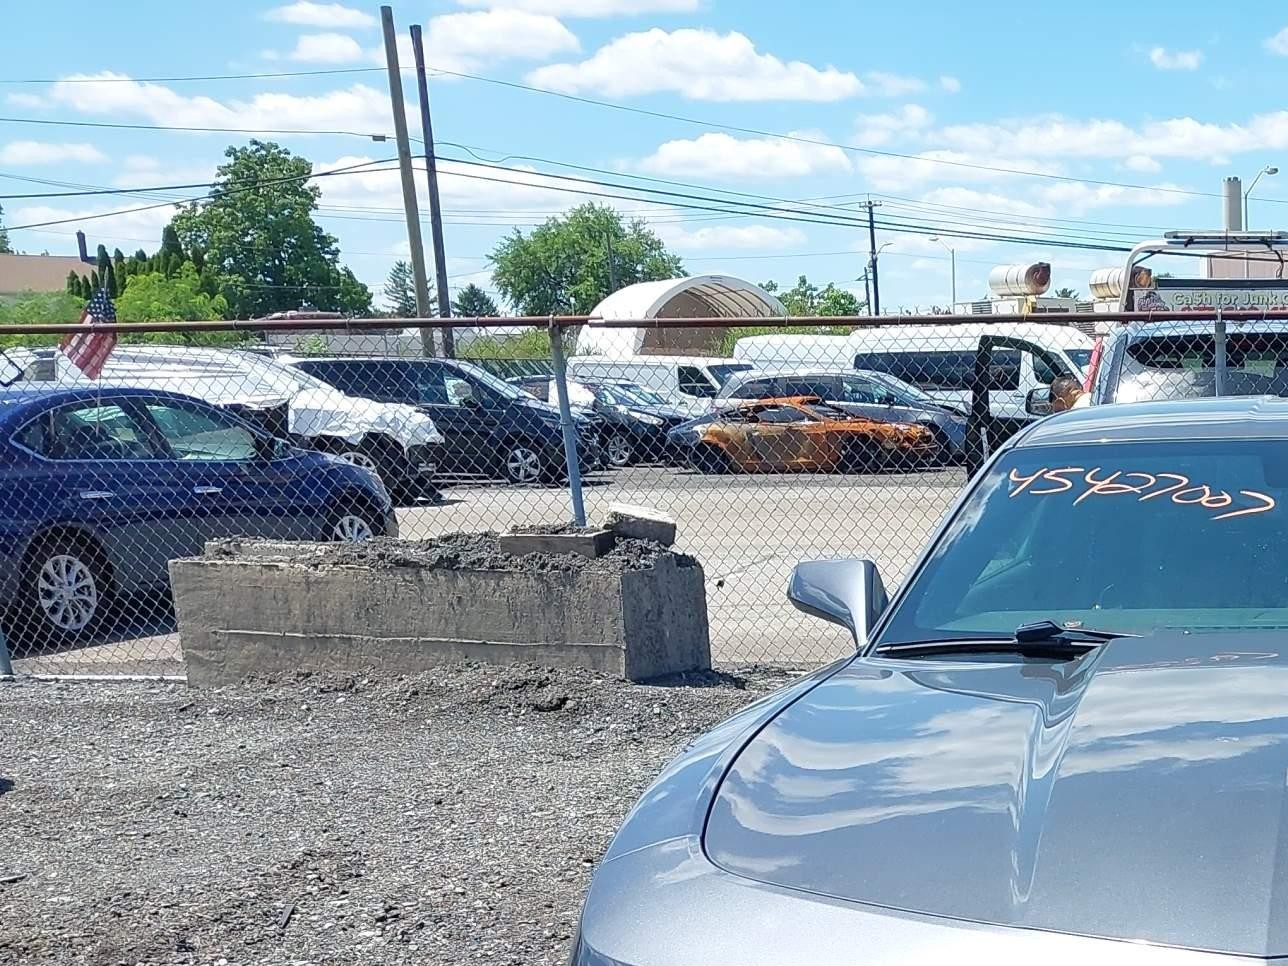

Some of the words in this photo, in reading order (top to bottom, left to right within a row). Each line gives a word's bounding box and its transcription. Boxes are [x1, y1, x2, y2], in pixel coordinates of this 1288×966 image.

[1216, 291, 1239, 306] for
[1243, 291, 1278, 306] Junk
[1008, 467, 1276, 521] 45427007
